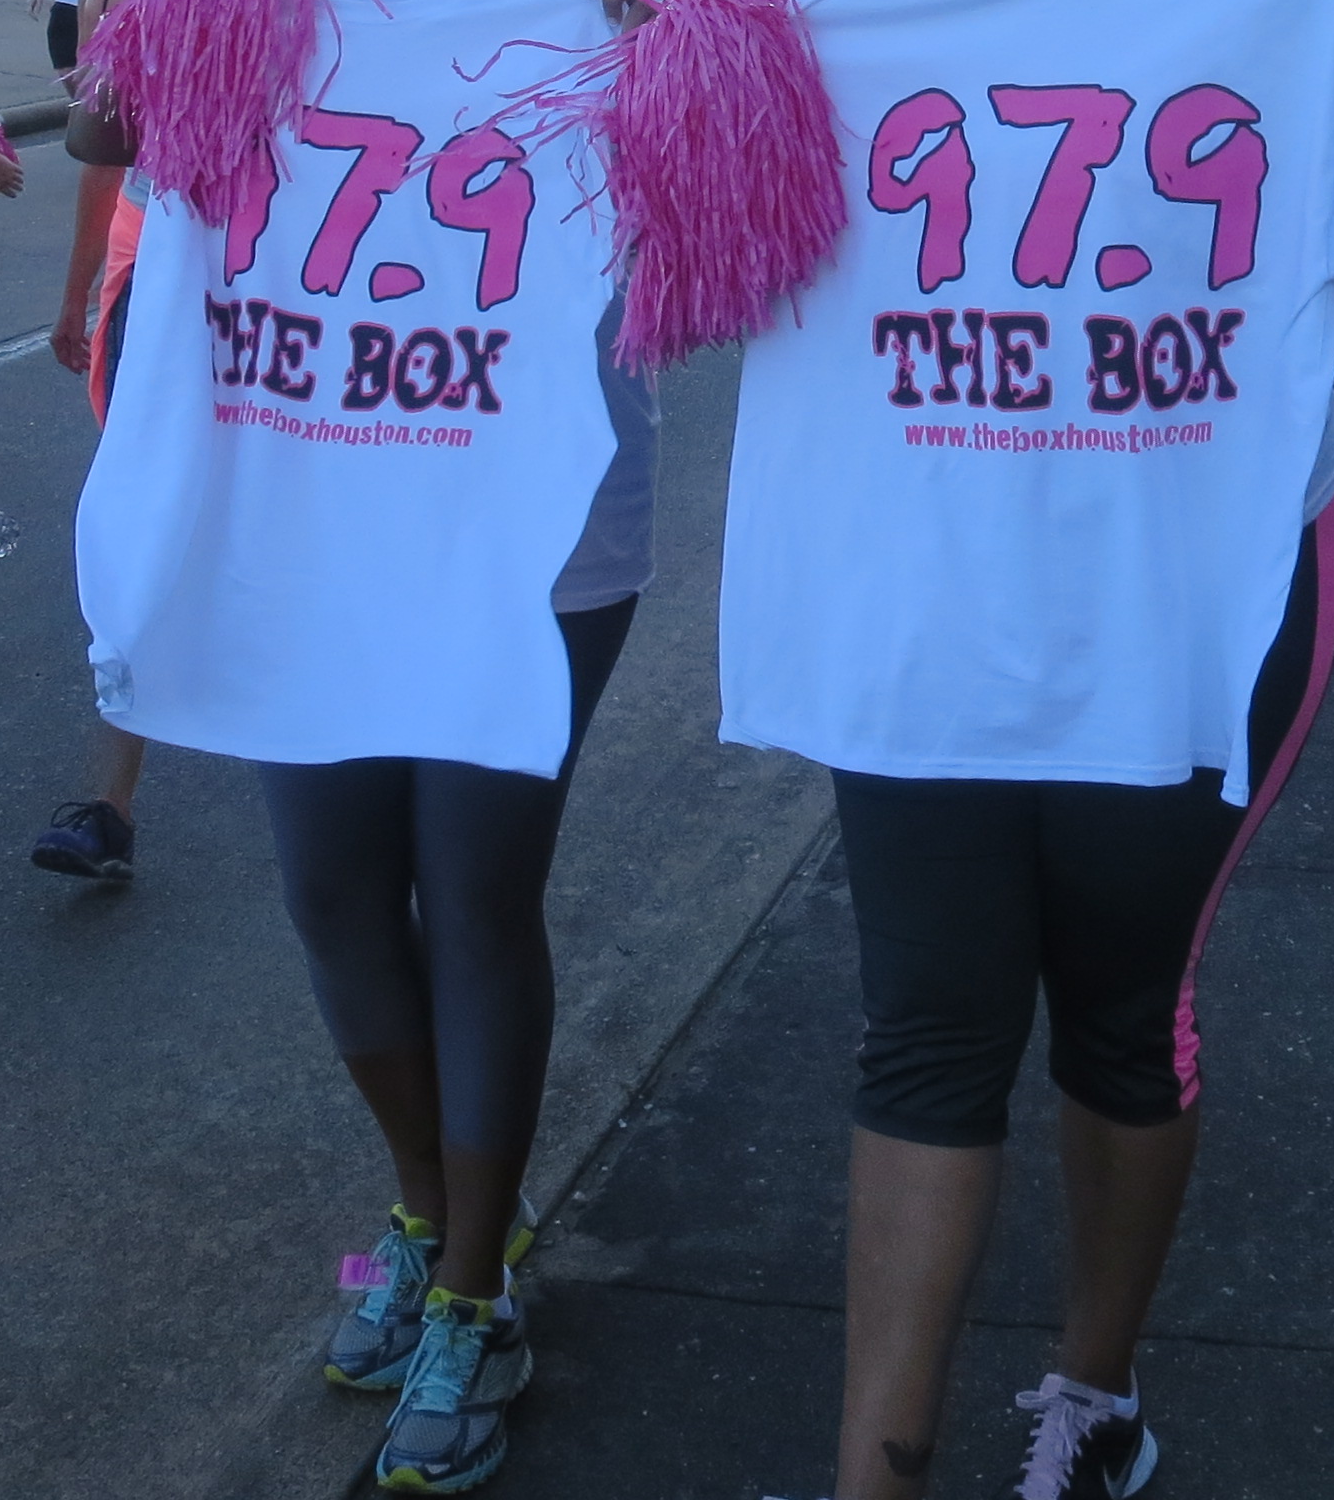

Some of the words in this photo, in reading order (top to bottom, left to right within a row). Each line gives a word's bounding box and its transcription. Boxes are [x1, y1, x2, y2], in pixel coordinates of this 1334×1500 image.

[868, 83, 1269, 294] 97.9
[340, 320, 511, 414] BOX
[872, 308, 1053, 413] THE
[1083, 307, 1246, 415] BOX
